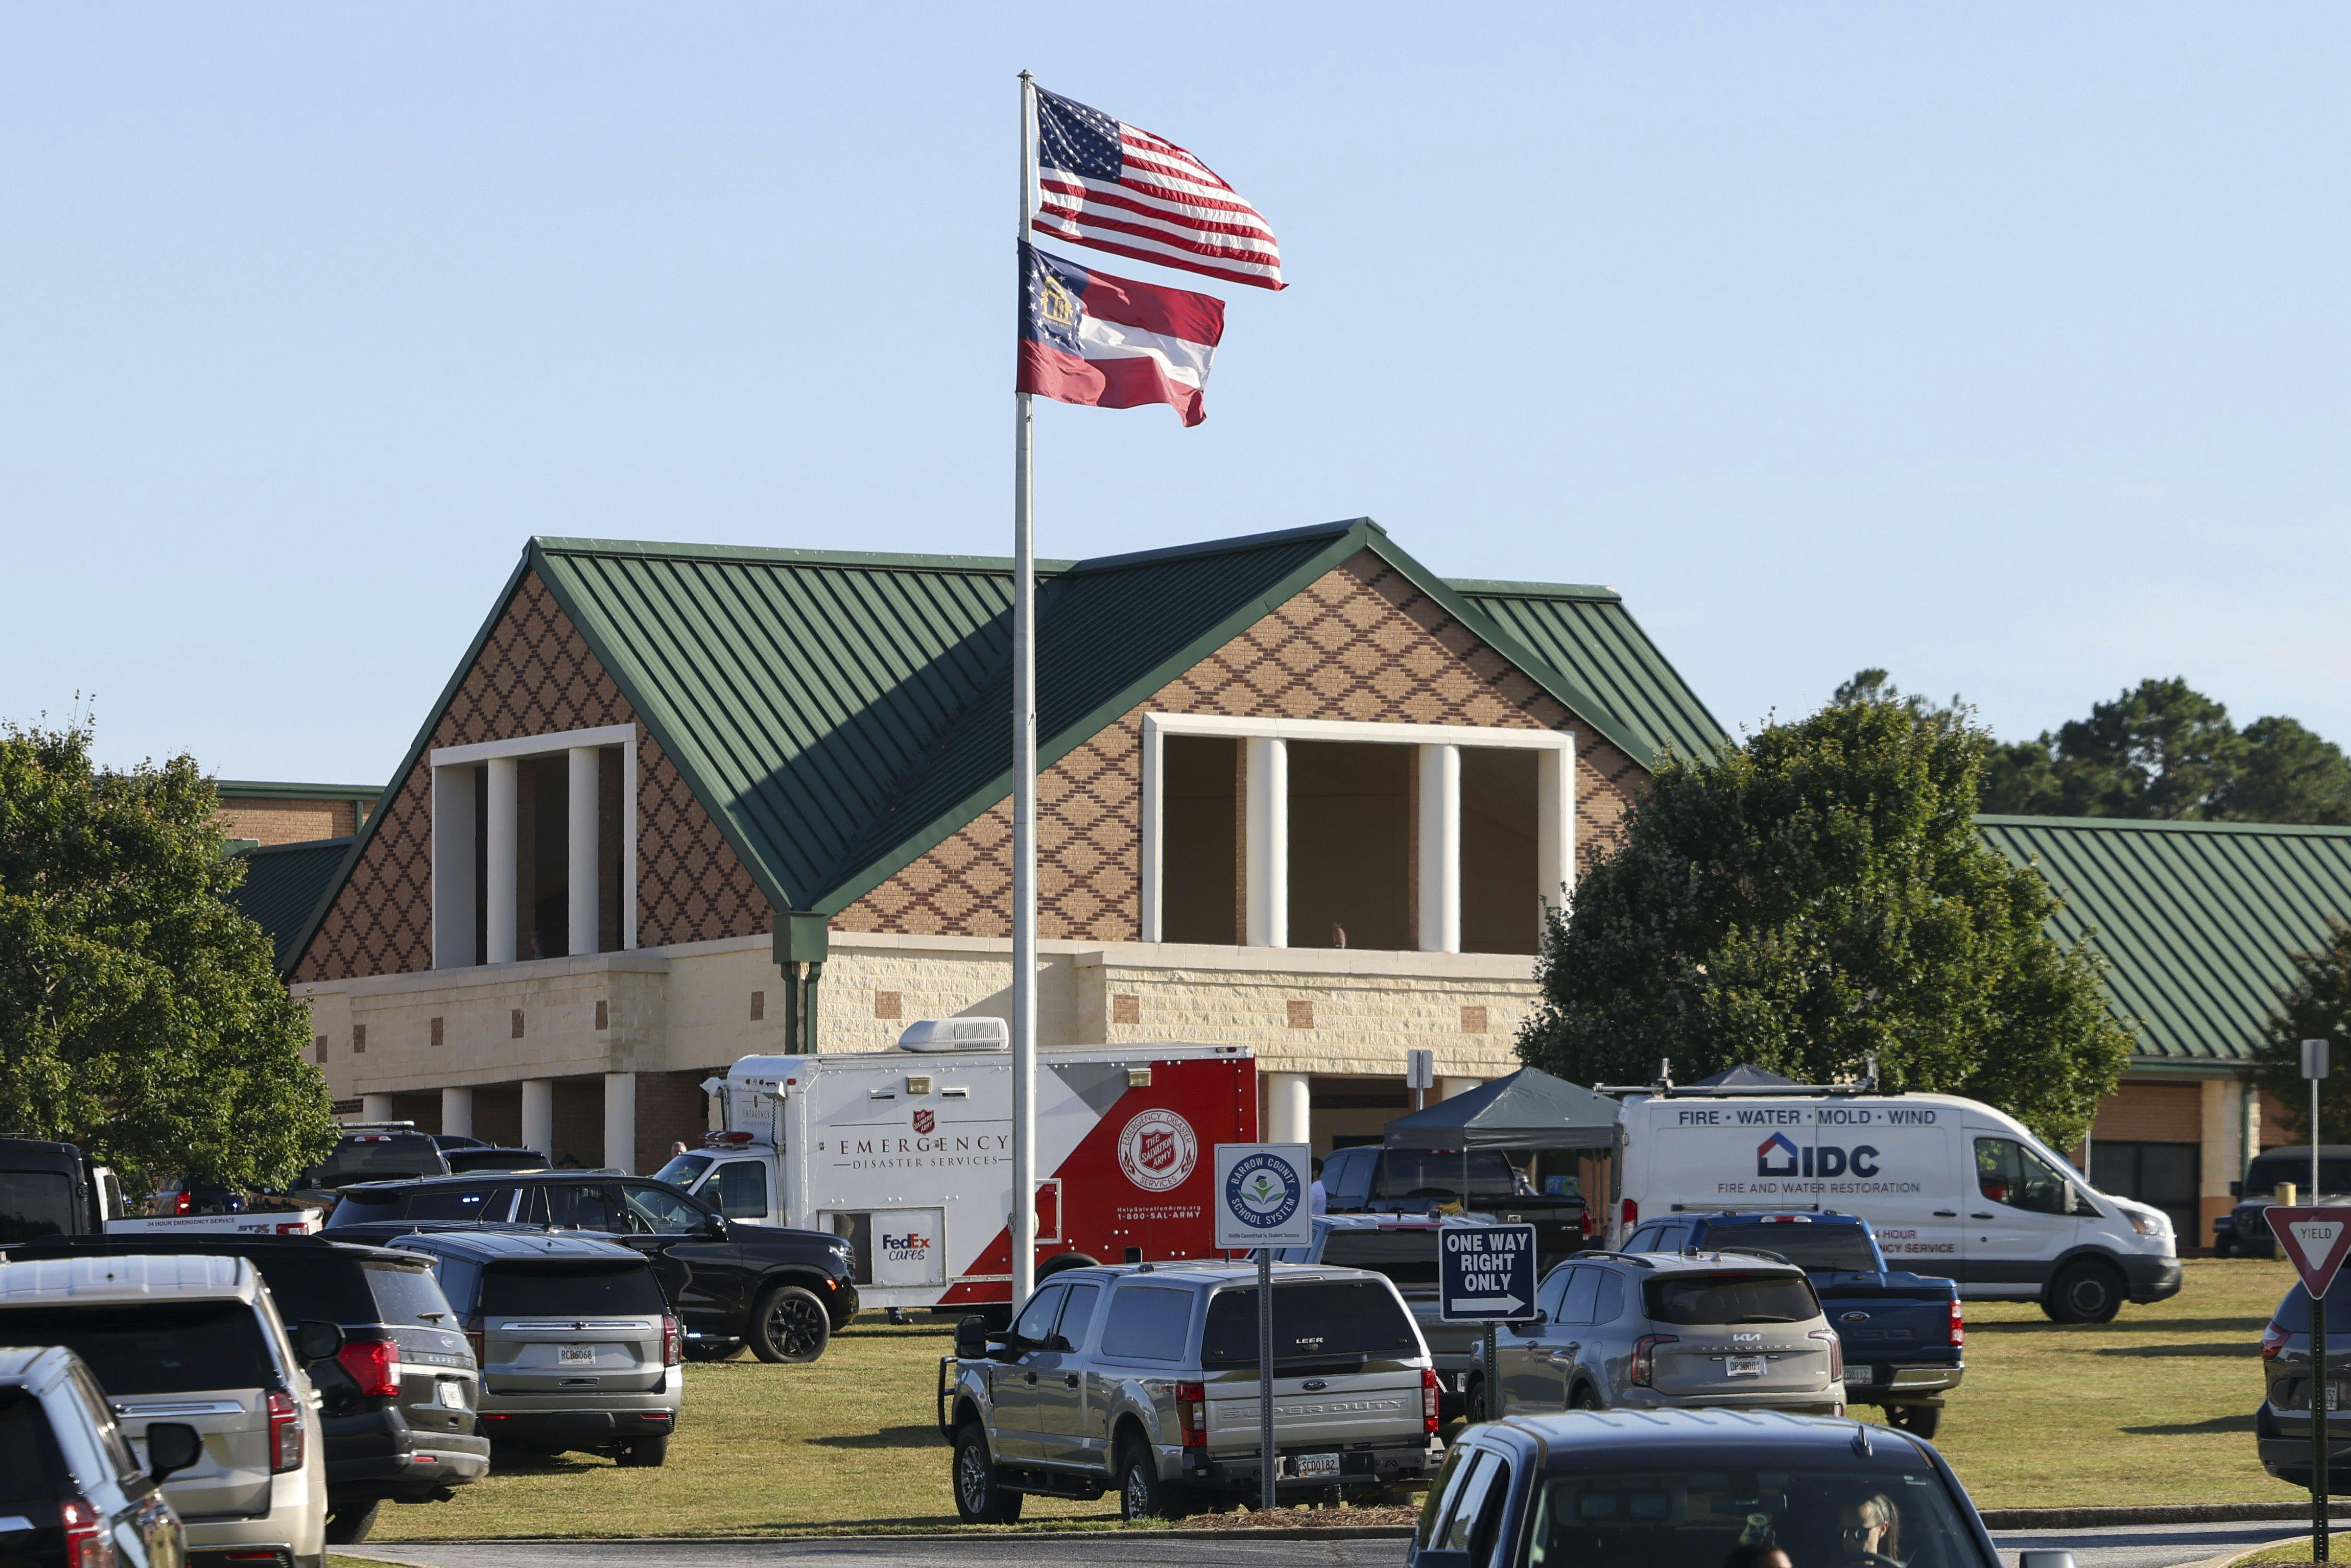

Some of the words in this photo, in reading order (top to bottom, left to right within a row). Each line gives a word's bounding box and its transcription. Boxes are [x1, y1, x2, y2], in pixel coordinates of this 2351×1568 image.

[743, 1110, 770, 1119] EMERGENCY
[1679, 1111, 1720, 1125] FIRE
[1737, 1110, 1800, 1124] WATER
[1818, 1110, 1870, 1124] MOLD
[1887, 1110, 1936, 1124] WIND
[1122, 1113, 1161, 1146] EMERGENCY
[1166, 1115, 1192, 1144] DISASTER
[840, 1135, 1008, 1155] EMERGENCY
[1146, 1134, 1160, 1148] THE
[1142, 1135, 1172, 1163] SALVATION
[853, 1158, 923, 1169] DISASTER
[931, 1156, 998, 1167] SERVICES
[1153, 1147, 1171, 1168] ARMY
[1802, 1145, 1880, 1178] IDC
[1231, 1157, 1263, 1185] BARROW
[1267, 1158, 1296, 1184] COUNTY
[1139, 1176, 1177, 1187] SERVICES
[1718, 1183, 1744, 1193] FIRE
[1750, 1183, 1777, 1193] AND
[1783, 1183, 1826, 1193] WATER
[1831, 1182, 1920, 1193] RESTORATION
[1118, 1211, 1200, 1220] 1-800-SAL-ARMY
[1231, 1198, 1261, 1225] SCHOOL
[1266, 1197, 1296, 1225] SYSTEM
[1883, 1230, 1916, 1239] HOUR
[2301, 1228, 2331, 1239] YIELD
[883, 1233, 930, 1250] FedEx
[1447, 1234, 1482, 1252] ONE
[1489, 1233, 1528, 1251] WAY
[1905, 1243, 1954, 1253] SERVICE
[889, 1249, 924, 1261] cares
[1462, 1253, 1514, 1272] RIGHT
[1465, 1273, 1511, 1291] ONLY
[1331, 1399, 1406, 1411] DUTY
